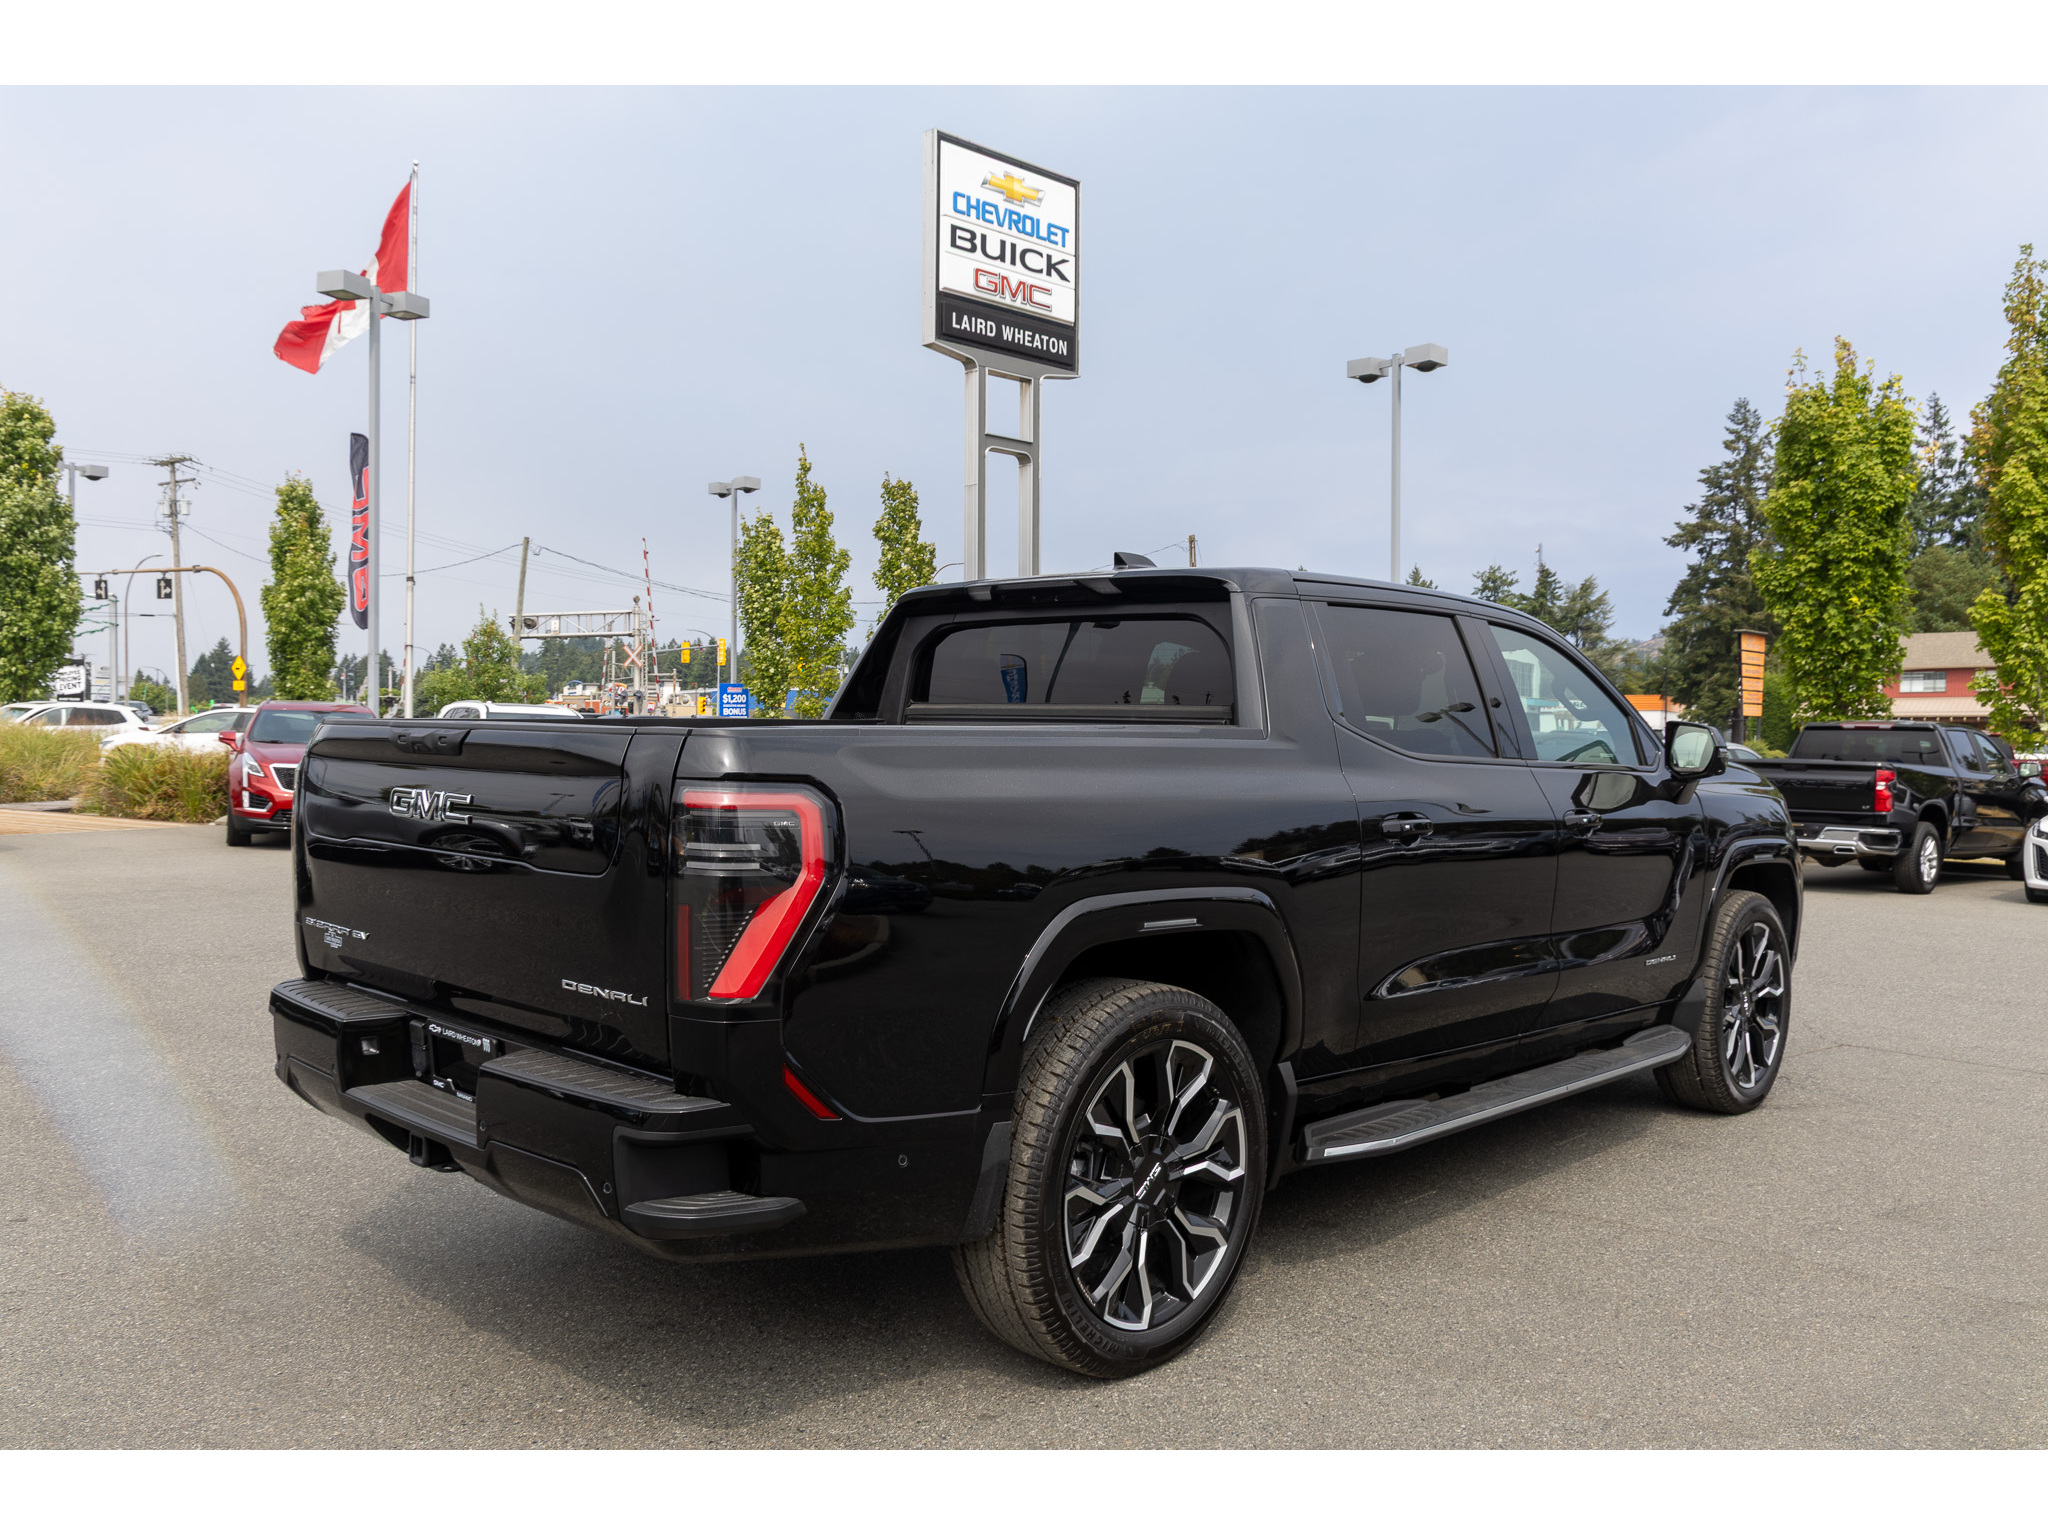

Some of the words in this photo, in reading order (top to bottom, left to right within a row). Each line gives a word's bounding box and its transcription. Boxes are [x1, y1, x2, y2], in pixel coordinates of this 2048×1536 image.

[953, 191, 1070, 248] CHEVROLET
[950, 223, 1070, 283] BUICK
[973, 267, 1052, 312] GMC
[952, 312, 997, 338] LAIRD
[1002, 323, 1068, 356] WHEATON
[59, 681, 81, 691] EVENT
[722, 693, 747, 704] $1,200
[722, 708, 747, 716] BONUS
[389, 787, 475, 826] GMC
[562, 979, 649, 1008] DENALI
